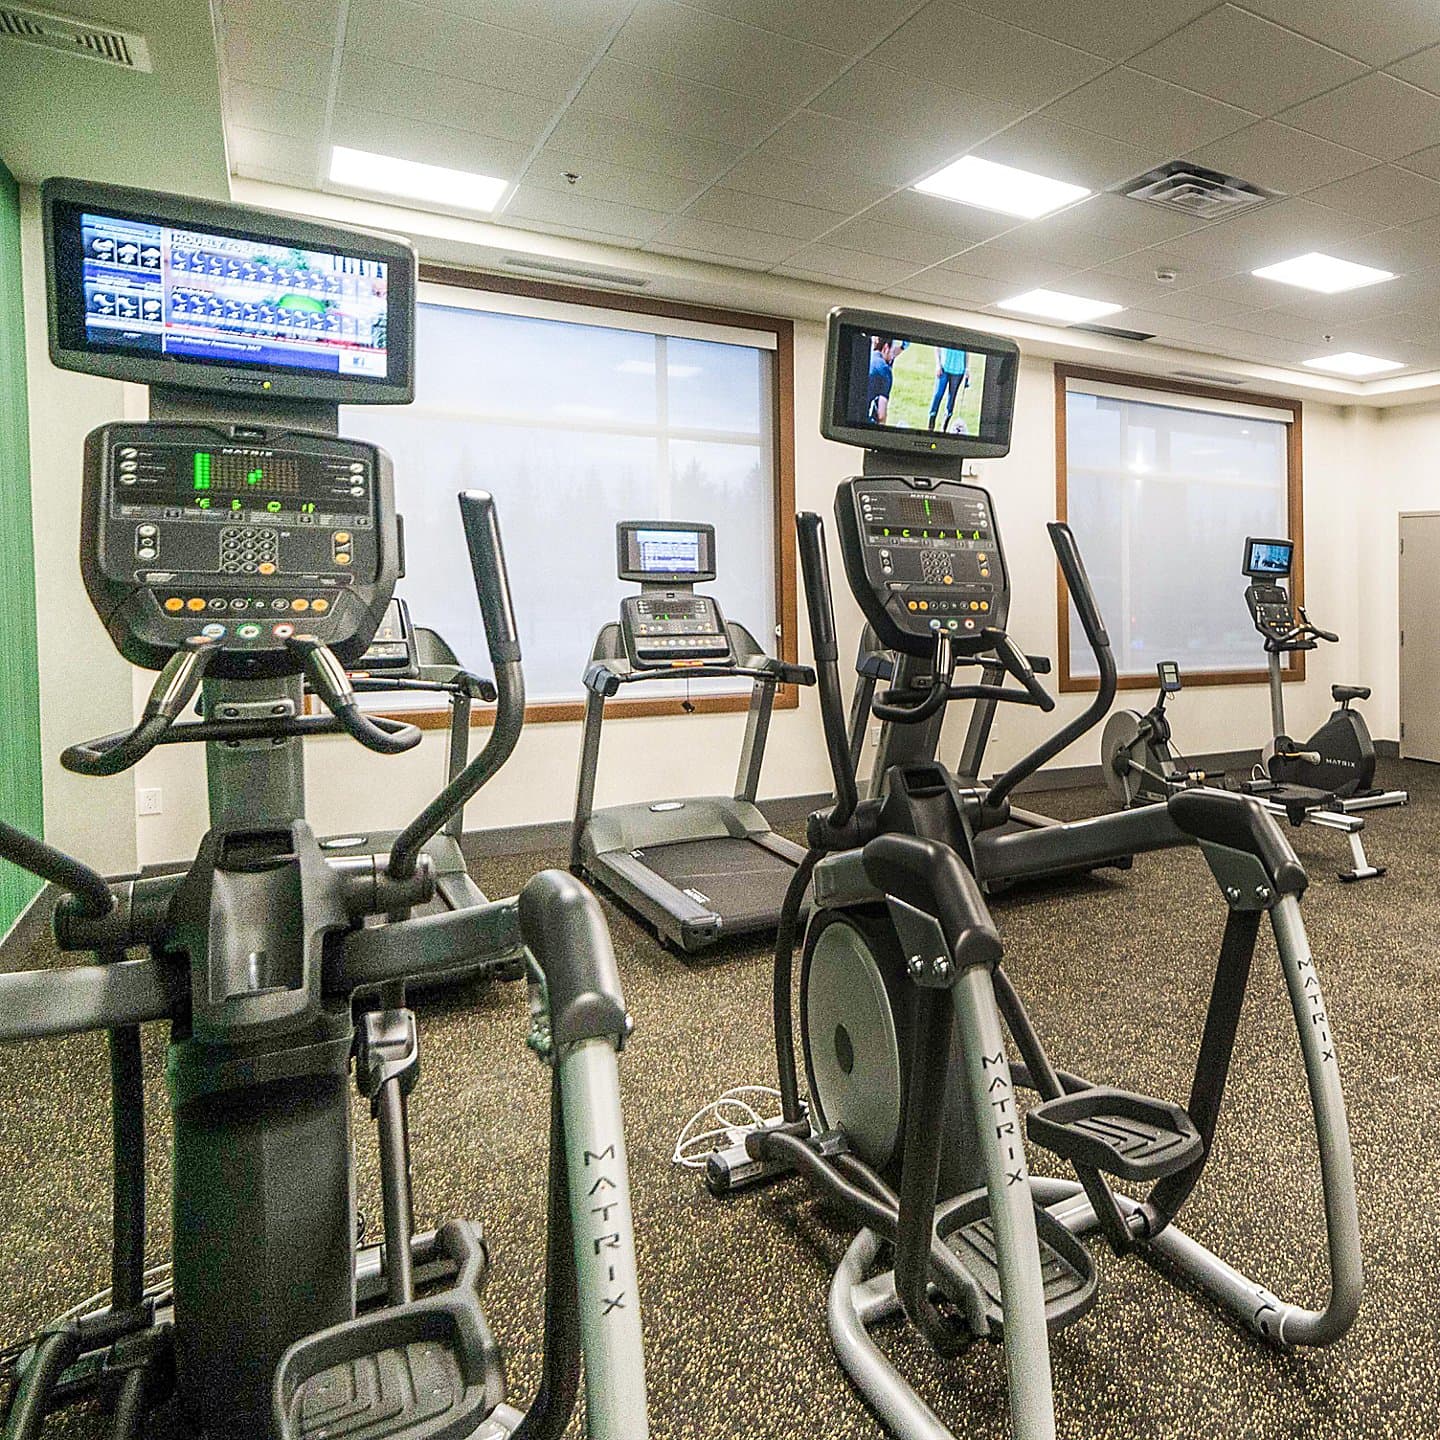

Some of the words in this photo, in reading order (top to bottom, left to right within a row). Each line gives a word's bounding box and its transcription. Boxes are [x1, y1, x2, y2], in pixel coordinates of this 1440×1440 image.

[222, 448, 273, 458] MATRIX
[1325, 757, 1356, 769] MATRIX
[1296, 957, 1334, 1063] MATRIX
[981, 1051, 1023, 1187] MATRIX
[583, 1144, 626, 1316] MATRIX
